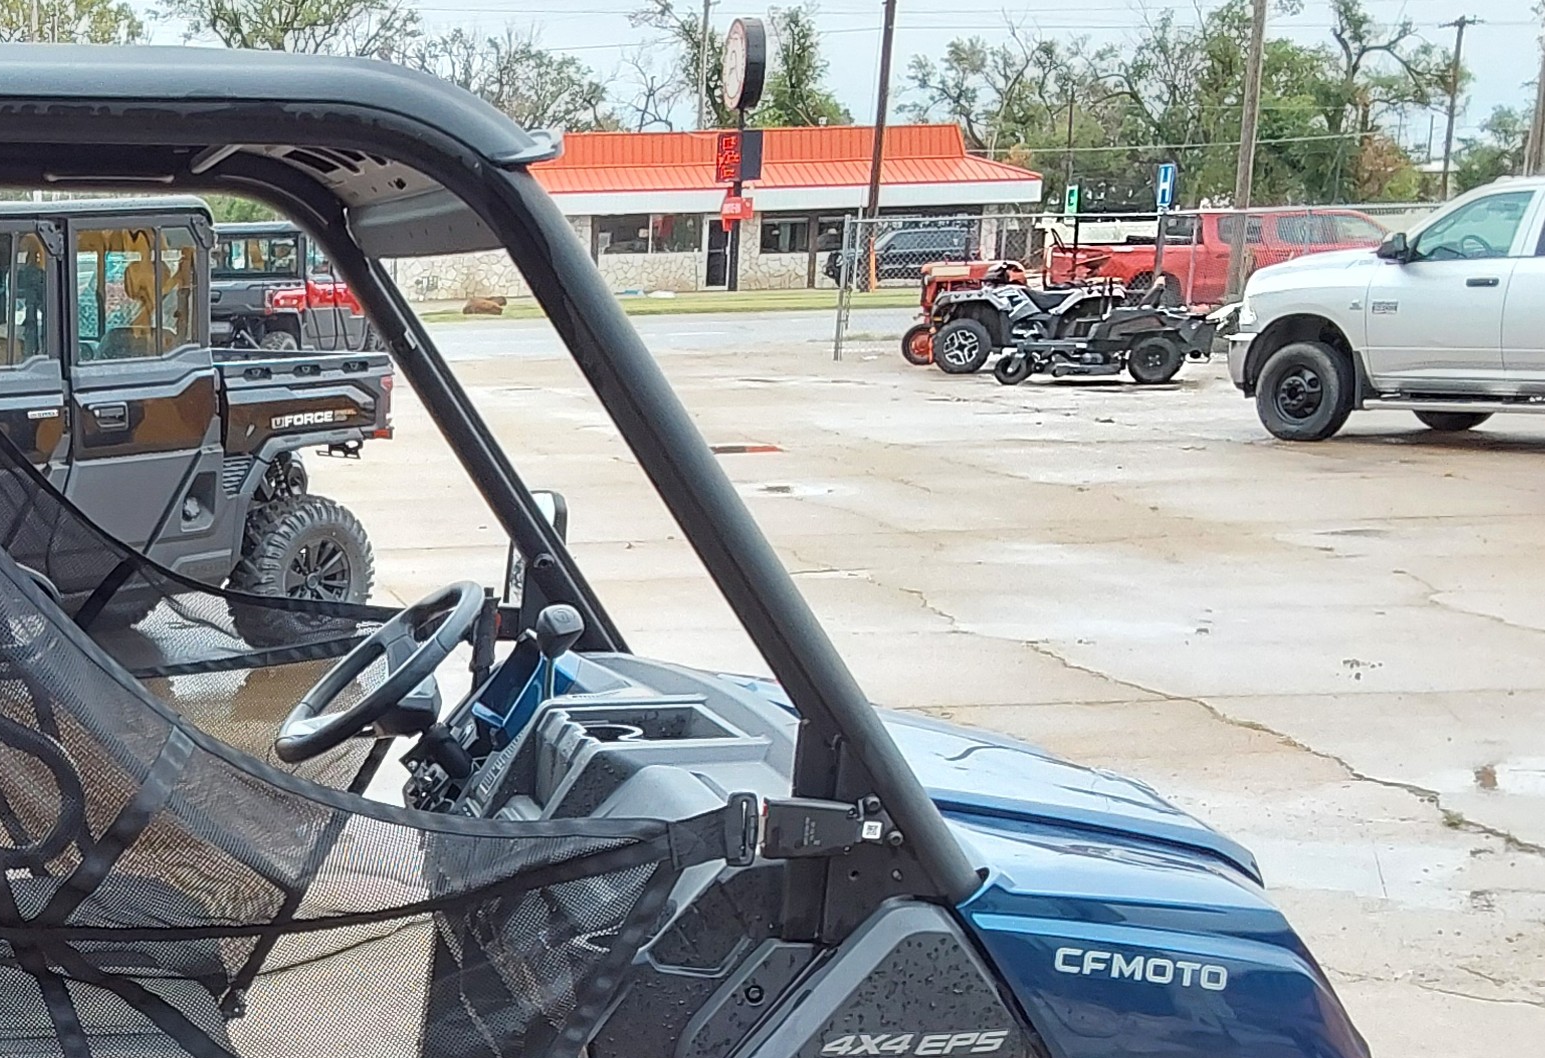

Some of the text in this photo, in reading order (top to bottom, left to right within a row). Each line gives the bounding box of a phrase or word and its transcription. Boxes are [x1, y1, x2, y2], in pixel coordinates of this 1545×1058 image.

[1158, 167, 1172, 204] H
[271, 410, 333, 429] UFORCE
[1054, 947, 1228, 991] CFMOTO
[821, 1030, 1009, 1056] 4X4 EPS
